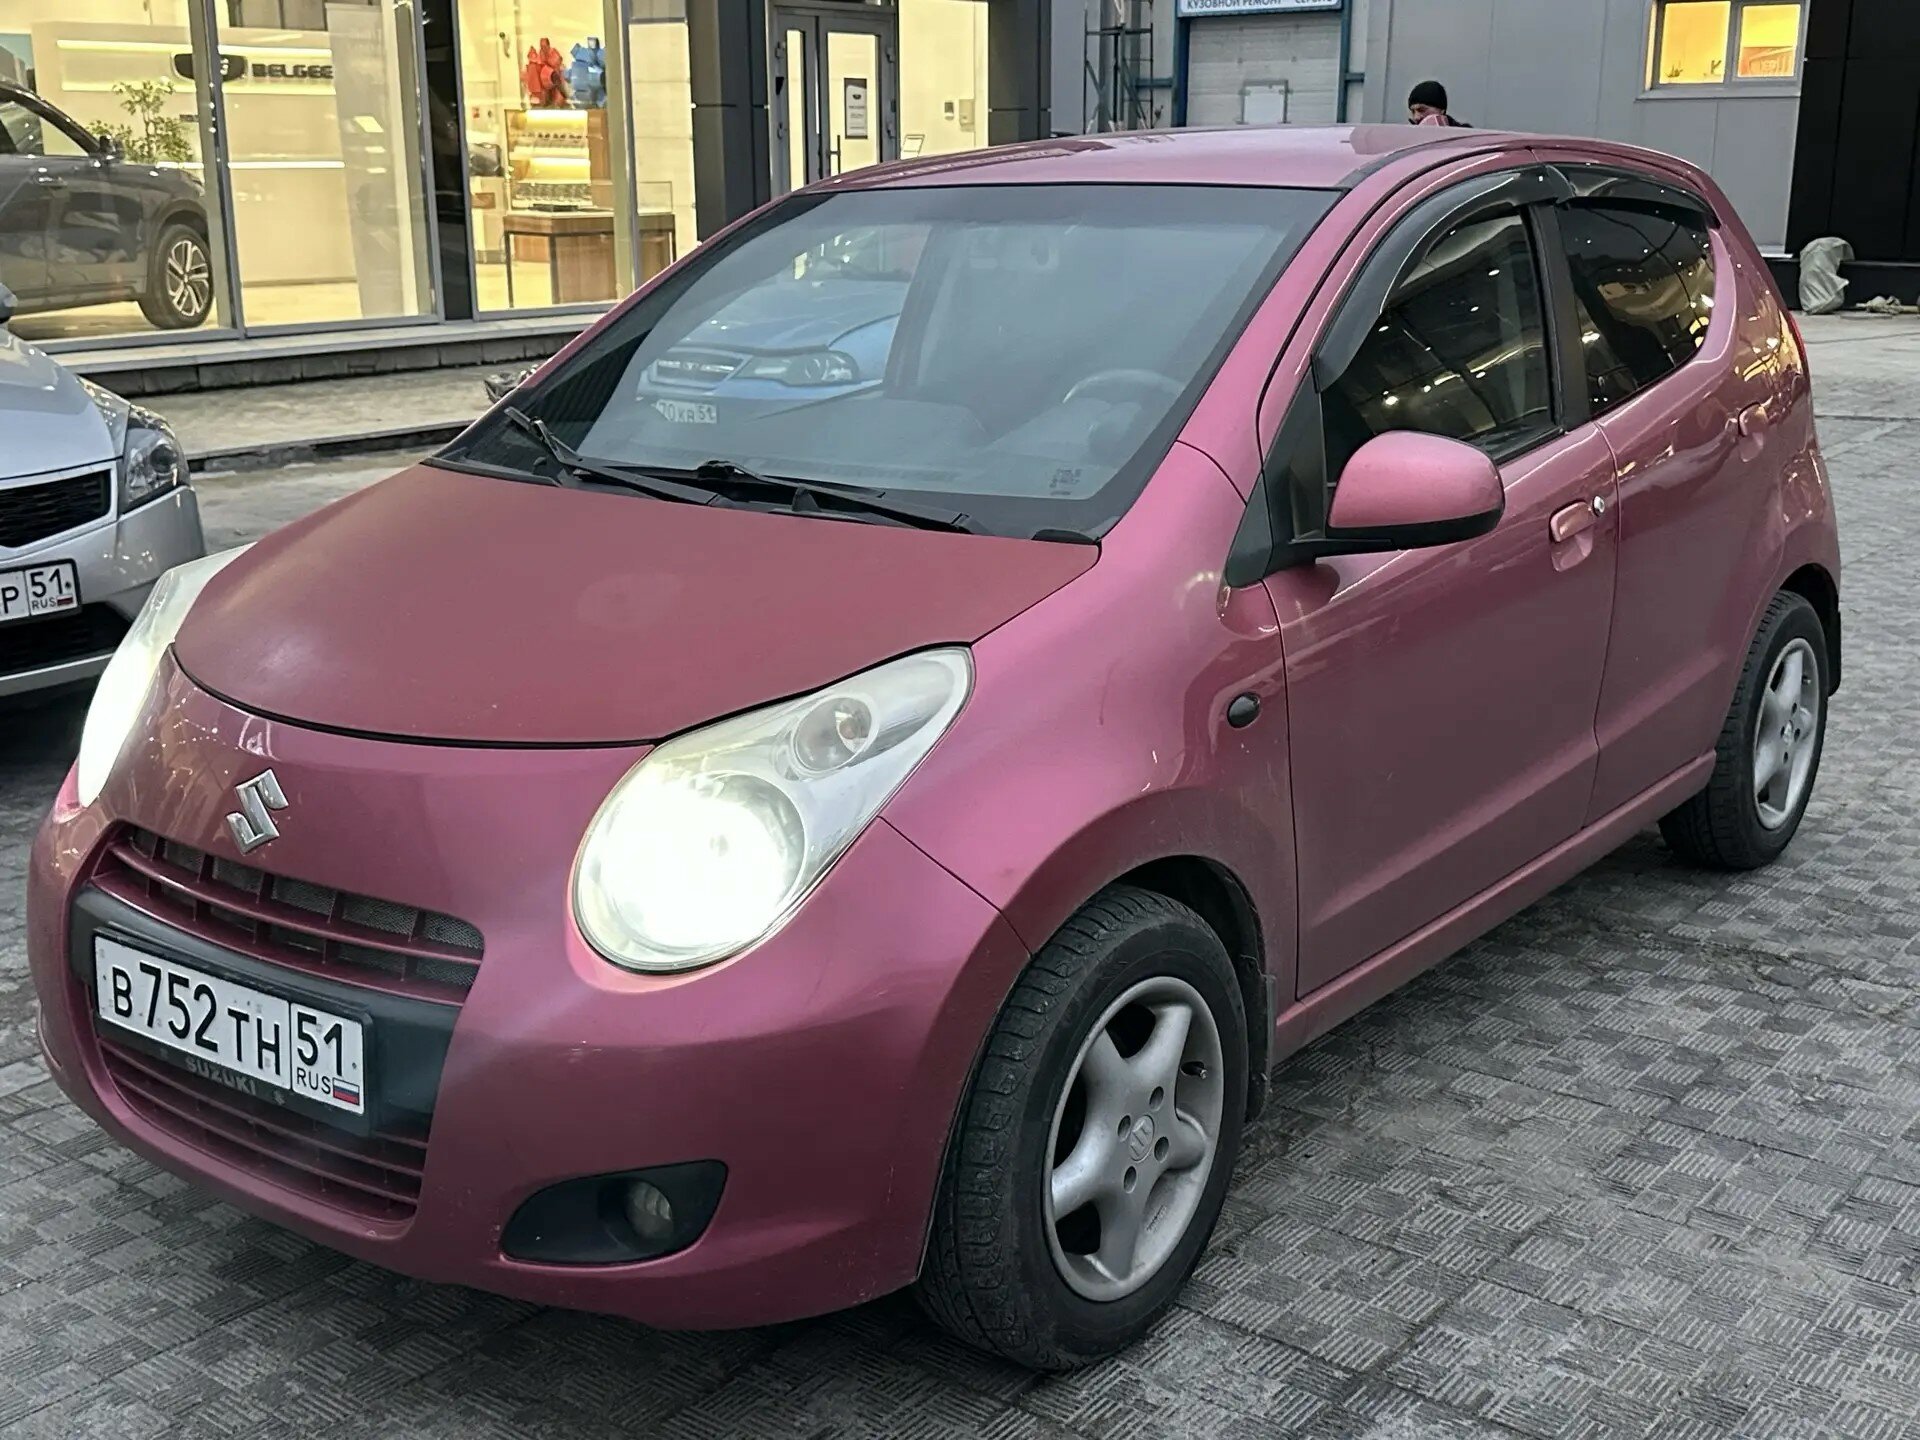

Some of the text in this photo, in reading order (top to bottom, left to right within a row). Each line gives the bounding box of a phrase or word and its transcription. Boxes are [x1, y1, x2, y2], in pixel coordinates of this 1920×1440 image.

[30, 568, 62, 598] 51
[31, 596, 57, 611] RUS
[297, 1011, 342, 1077] 51
[185, 1057, 256, 1096] SUZUKI
[296, 1067, 331, 1095] RUS
